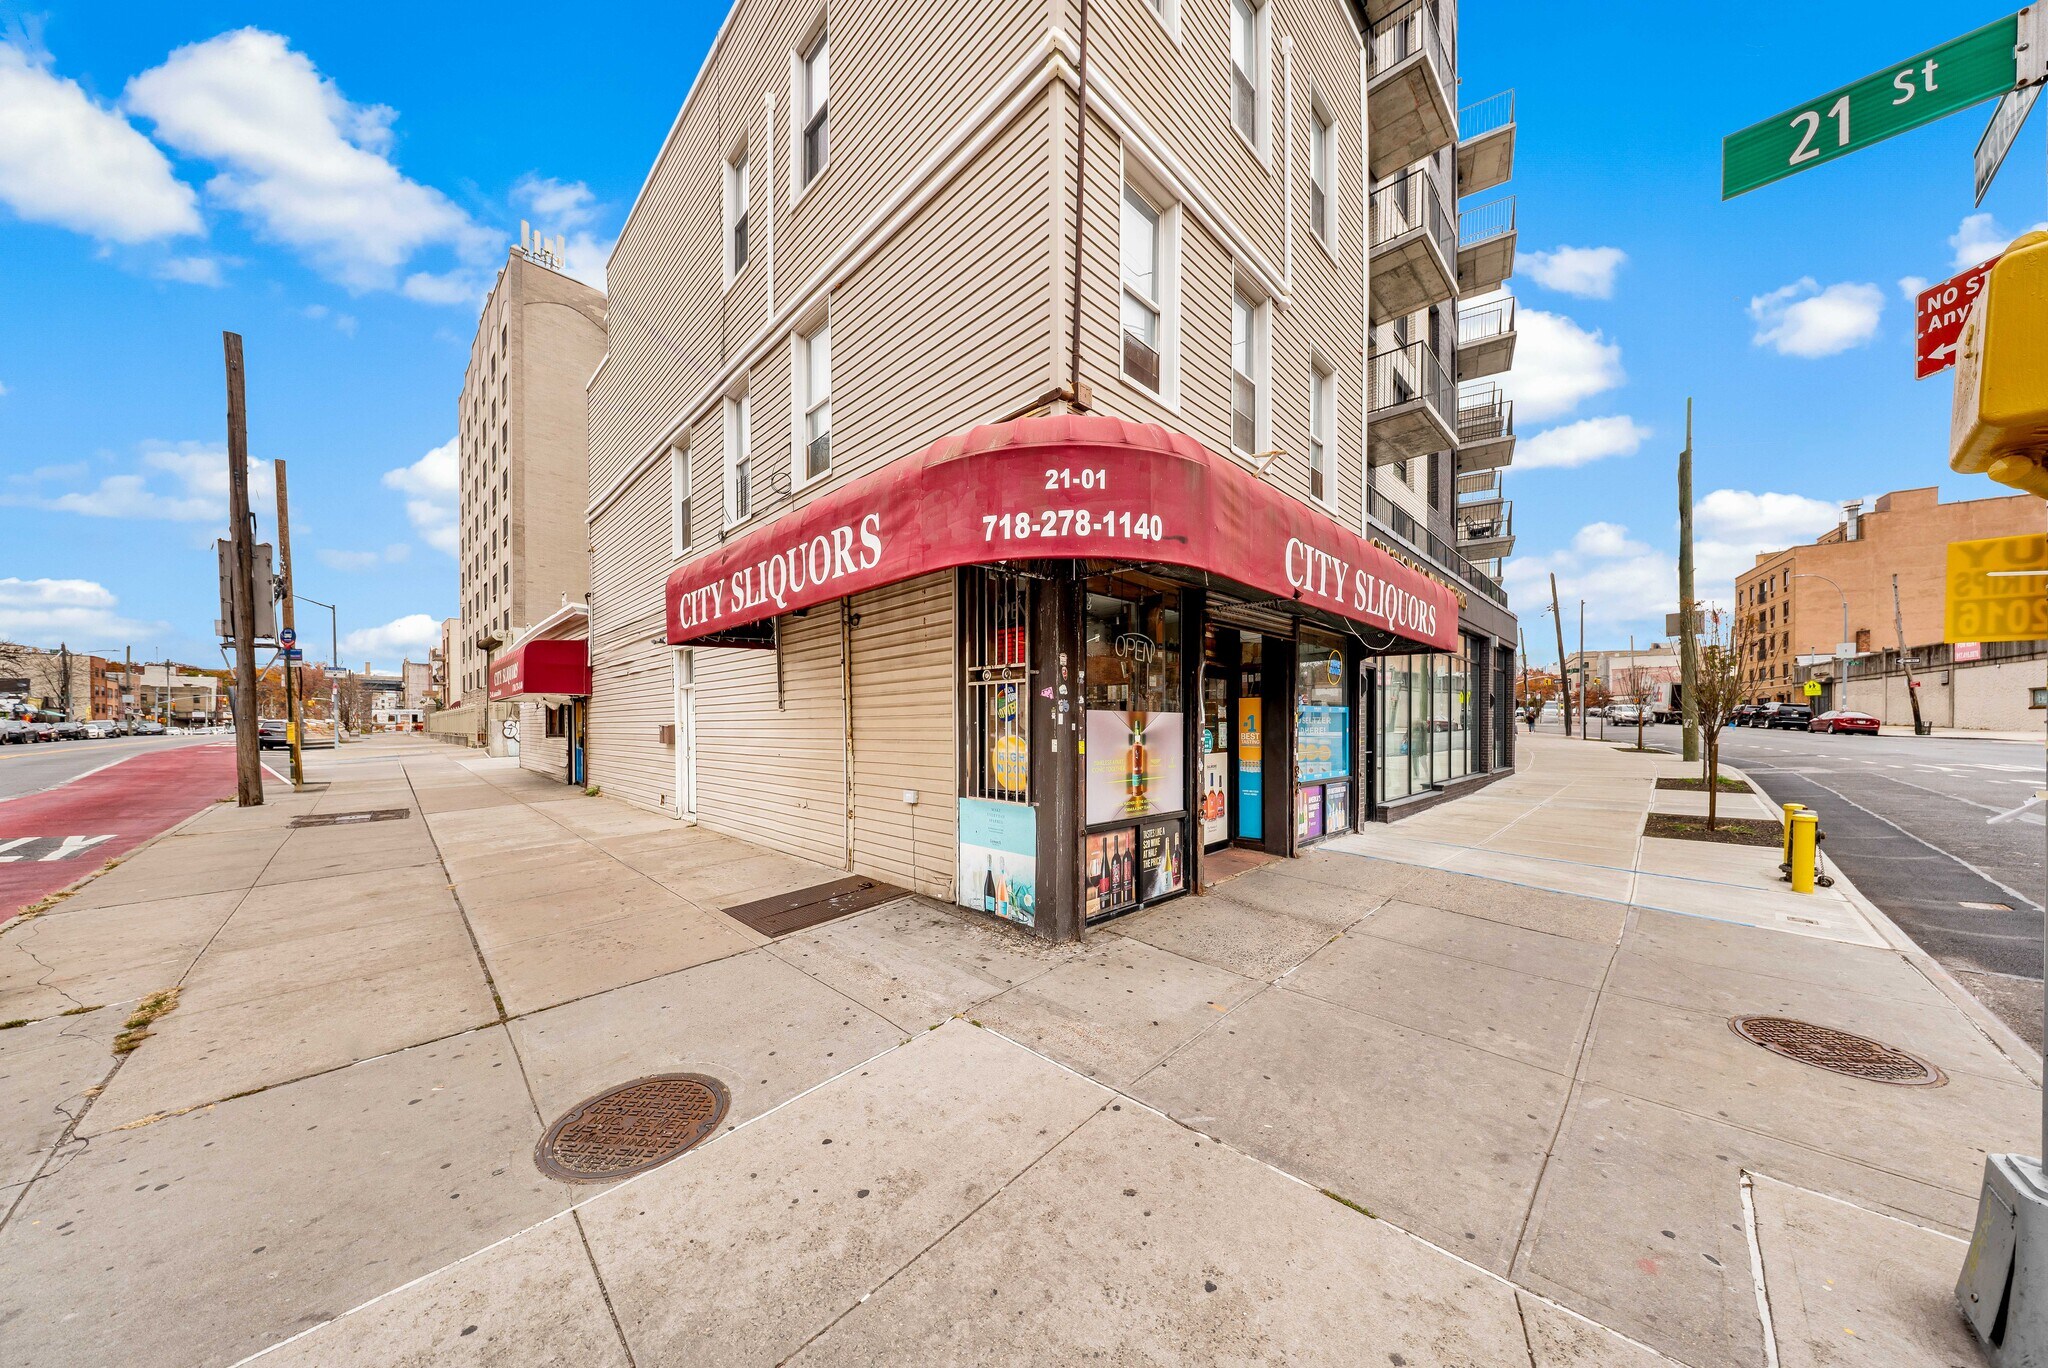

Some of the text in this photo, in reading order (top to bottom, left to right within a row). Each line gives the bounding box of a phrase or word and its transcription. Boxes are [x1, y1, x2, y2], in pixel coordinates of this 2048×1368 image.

[1789, 59, 1939, 166] 21 St
[1927, 286, 1958, 314] NO
[1927, 300, 1973, 334] Any
[1045, 468, 1106, 490] 21-01
[982, 509, 1163, 542] 718-278-1140
[679, 512, 882, 630] CITY SLIQUORS
[1285, 537, 1349, 603] CITY
[1354, 569, 1436, 637] SLIQUORS
[1115, 635, 1153, 664] OPEN
[1240, 732, 1260, 740] BEST
[633, 1118, 690, 1129] SEWER
[581, 1134, 616, 1144] MADE
[628, 1138, 658, 1147] INDIA
